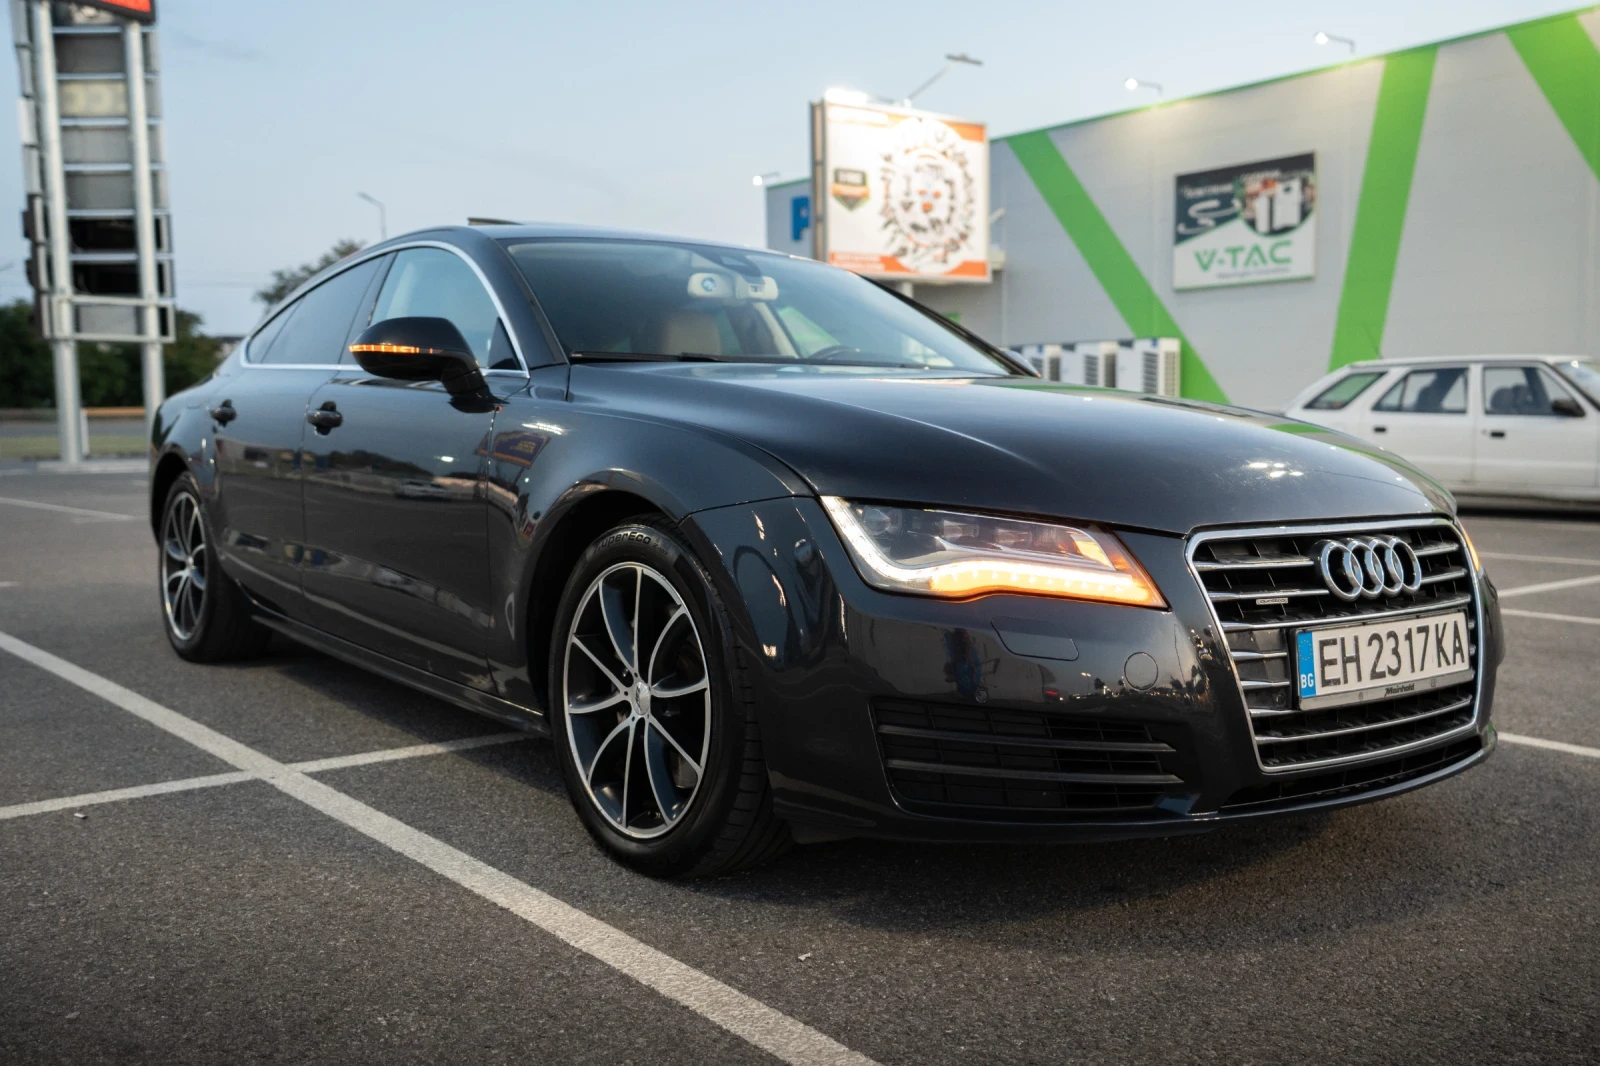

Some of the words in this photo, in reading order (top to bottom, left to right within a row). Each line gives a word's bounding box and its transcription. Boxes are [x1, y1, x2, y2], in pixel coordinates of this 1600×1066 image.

[1194, 240, 1292, 272] V-TAC
[1301, 672, 1315, 689] BG
[1318, 635, 1362, 688] EH
[1367, 625, 1430, 681] 2317
[1435, 620, 1465, 668] KA
